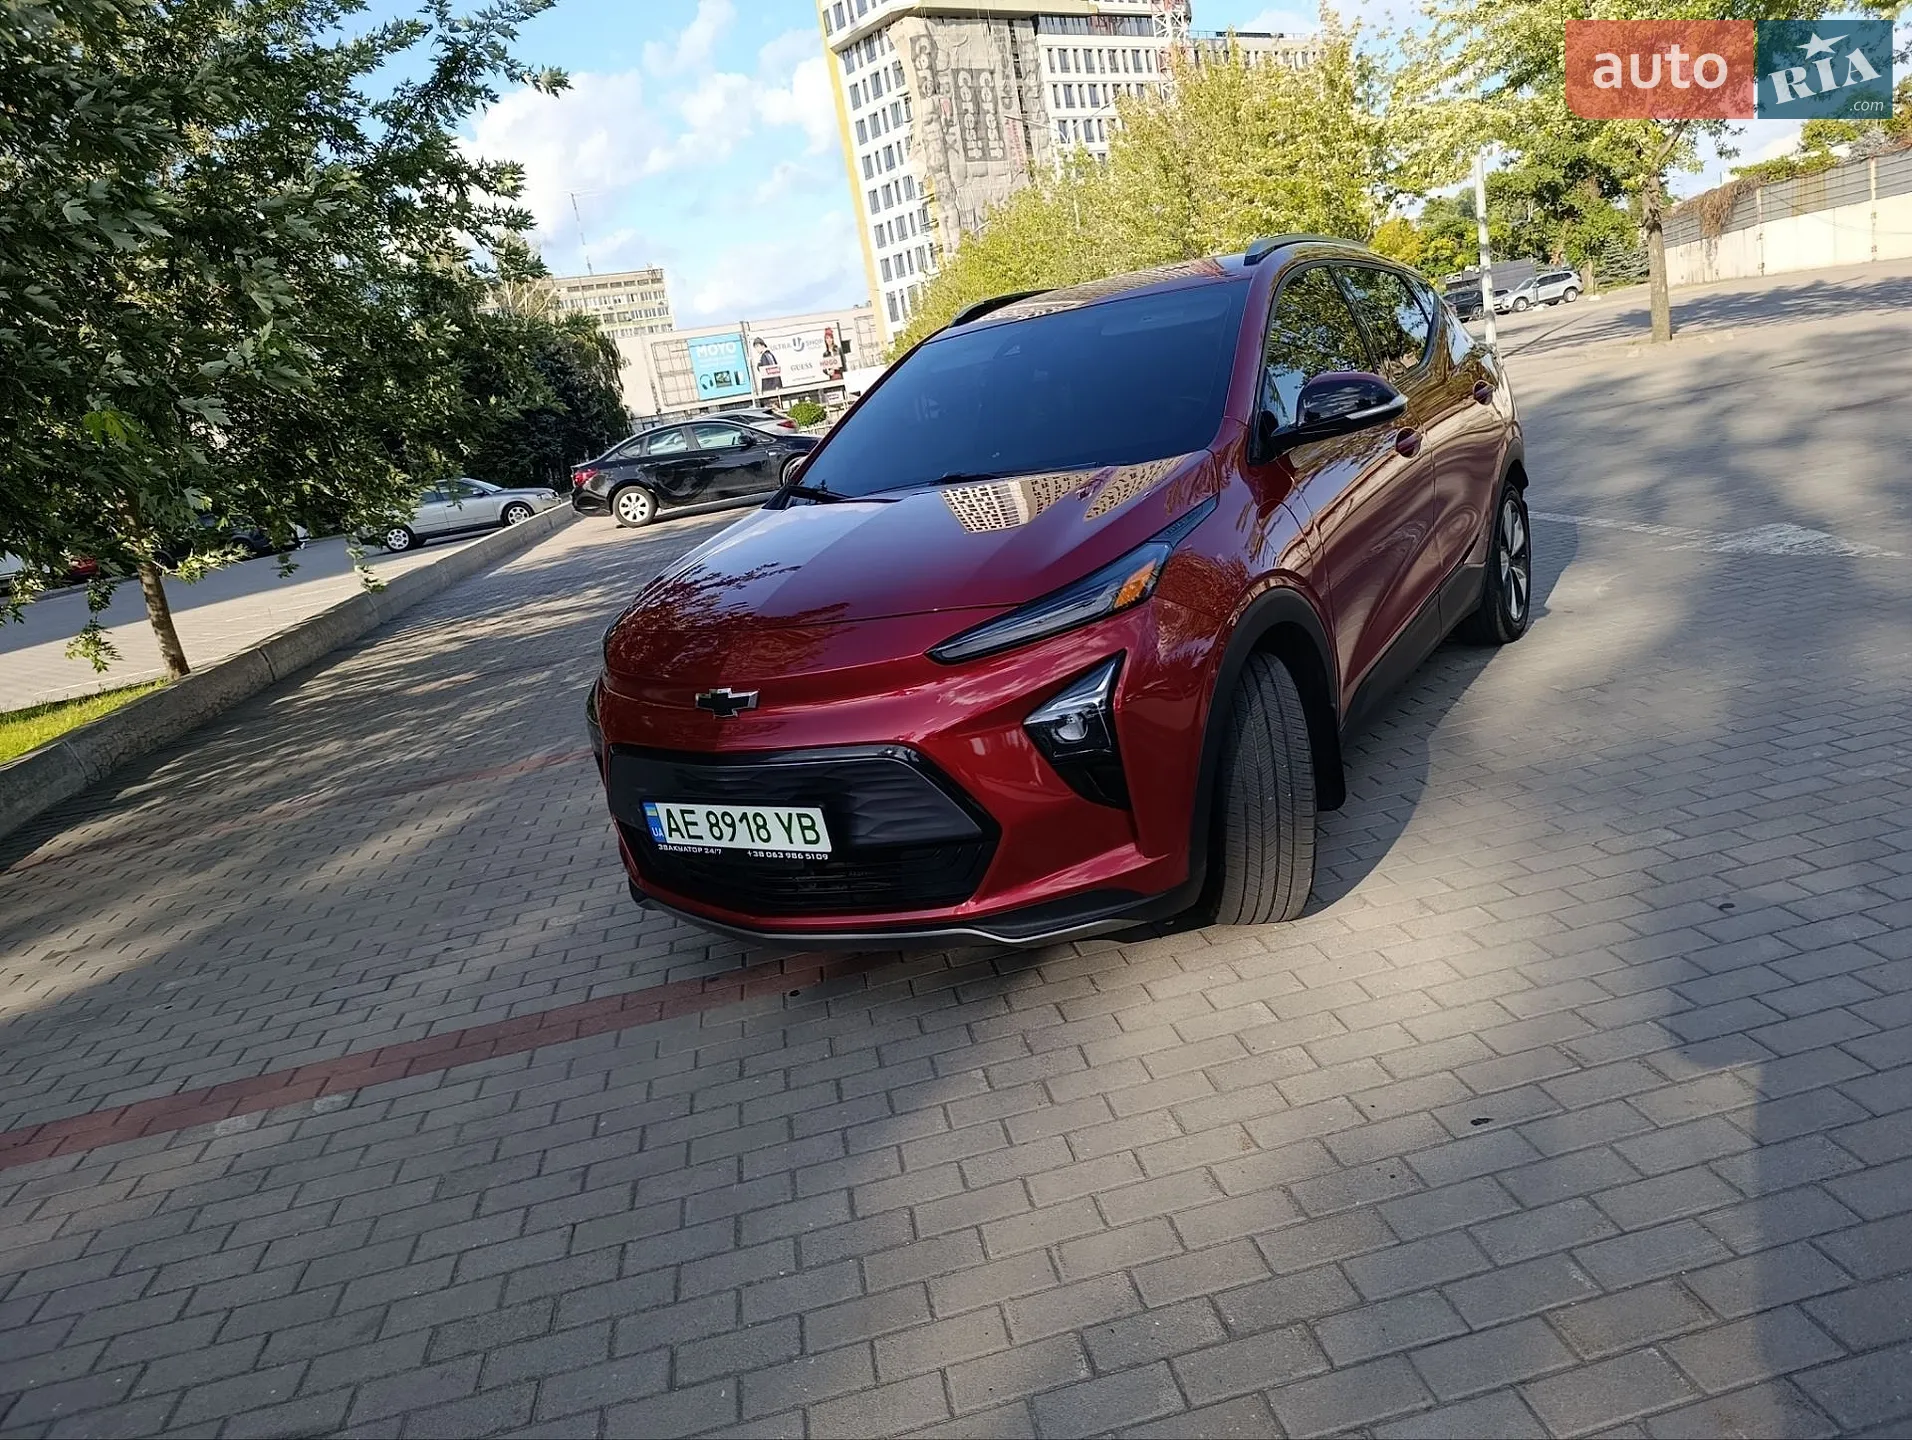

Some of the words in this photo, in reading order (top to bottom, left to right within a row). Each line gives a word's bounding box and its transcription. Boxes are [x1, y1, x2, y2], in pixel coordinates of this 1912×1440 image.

[696, 341, 737, 358] MOYO
[790, 361, 814, 371] GUESS
[666, 808, 704, 840] AE
[705, 810, 772, 844] 8918
[773, 812, 821, 845] YB
[651, 827, 665, 838] UA
[703, 847, 722, 855] 24/7
[747, 849, 765, 858] +38
[785, 852, 804, 860] 986
